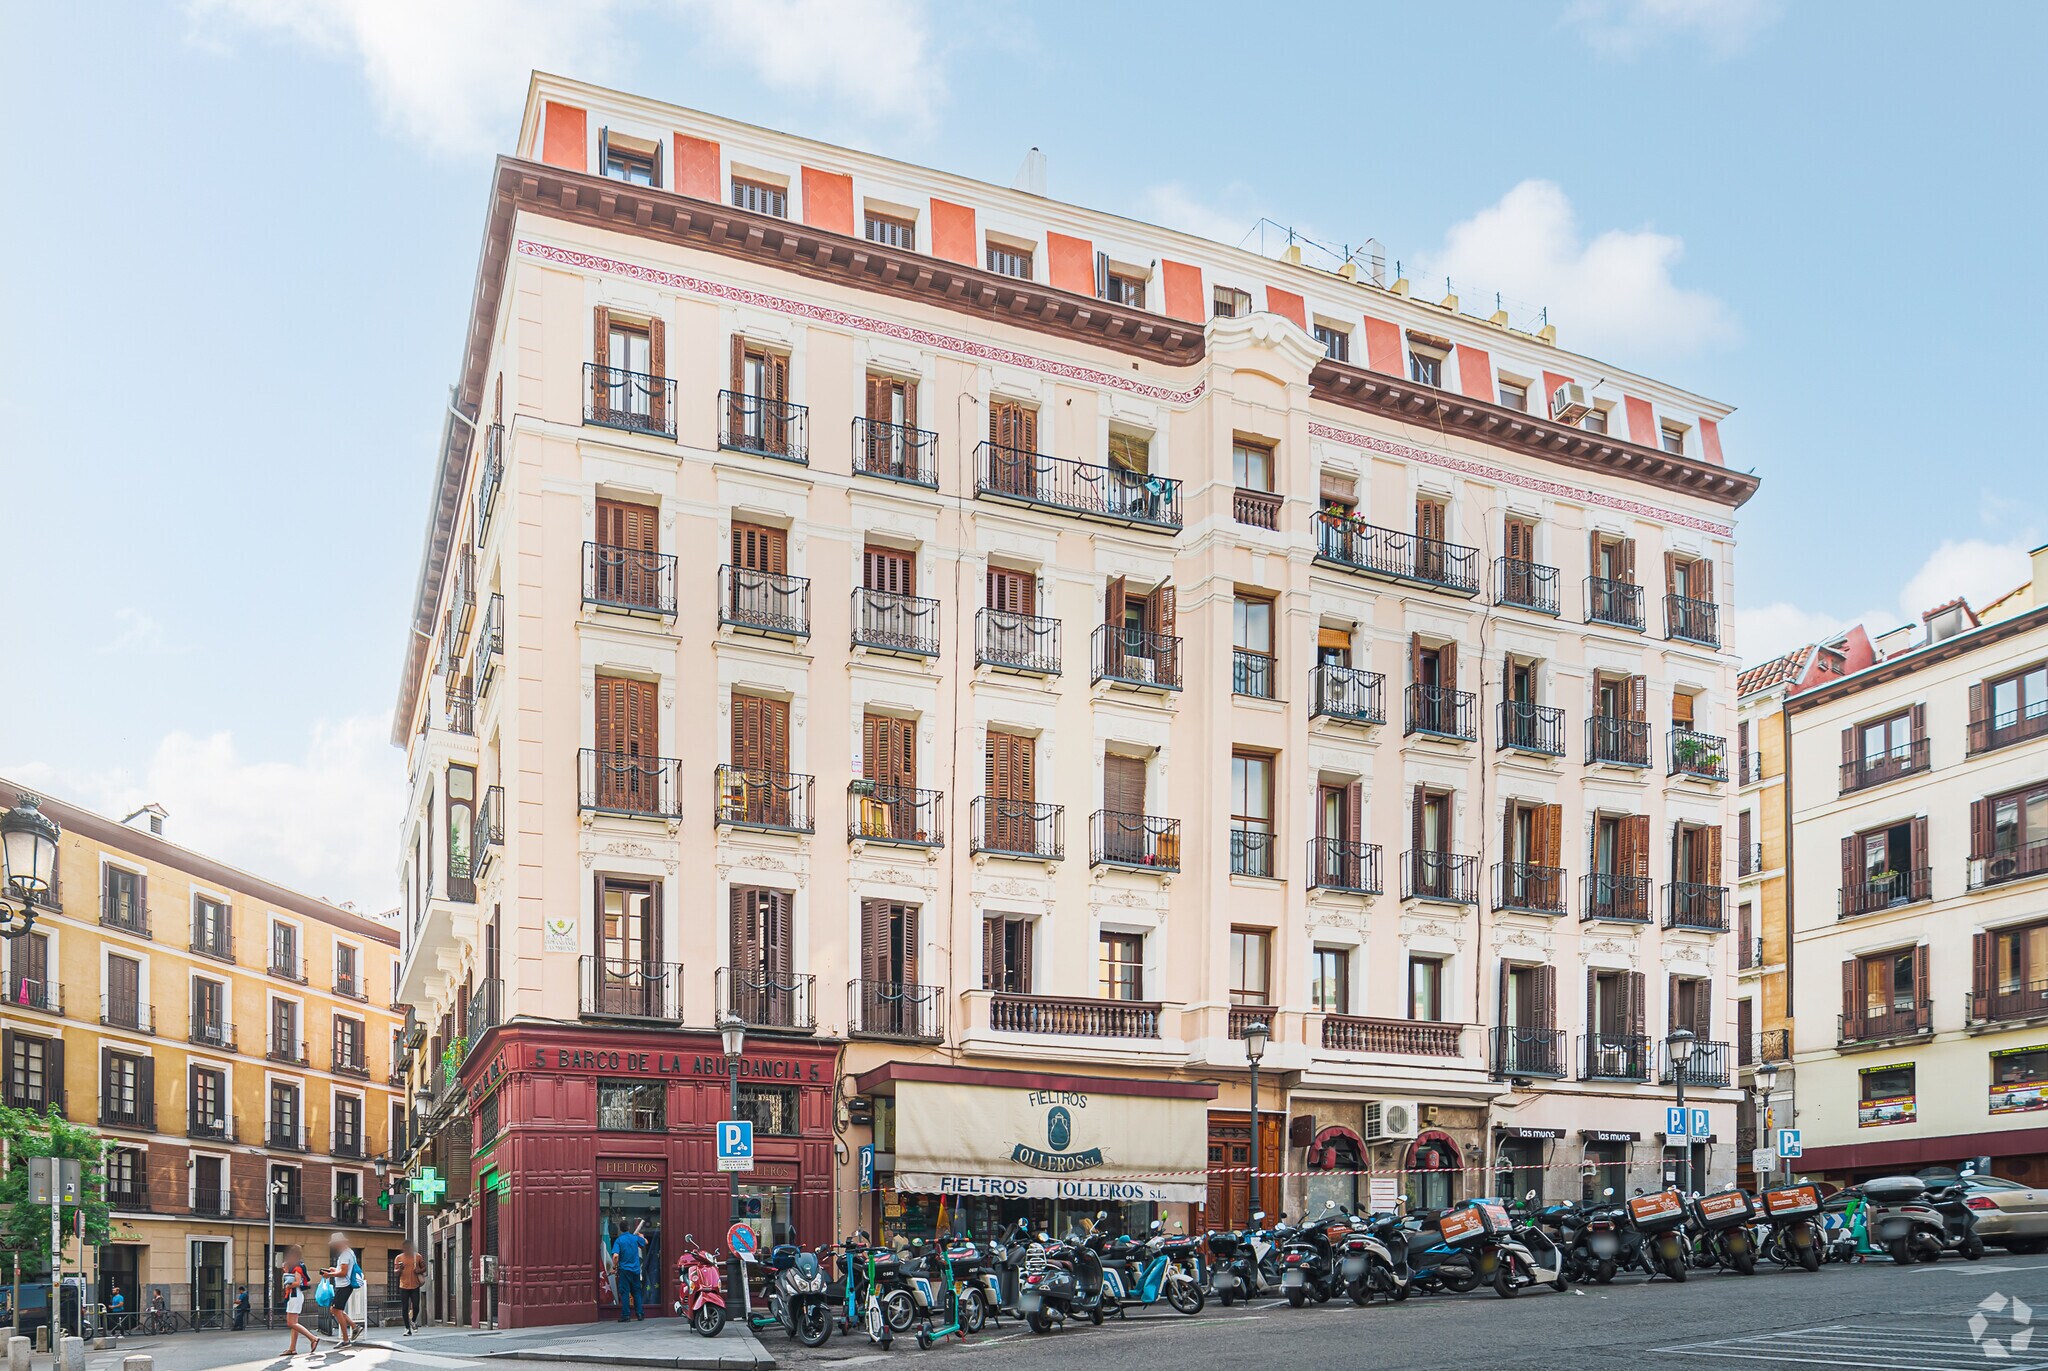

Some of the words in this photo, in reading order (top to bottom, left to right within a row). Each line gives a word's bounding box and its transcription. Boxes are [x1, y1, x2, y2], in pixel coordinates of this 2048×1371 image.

[558, 1048, 620, 1070] BARCO
[627, 1052, 650, 1071] DE
[658, 1053, 681, 1074] LA
[693, 1055, 802, 1080] ABUDANCIA
[809, 1063, 819, 1082] 5
[1028, 1091, 1088, 1109] FIELTROS
[1519, 1127, 1532, 1138] las
[1533, 1130, 1555, 1138] muns
[1671, 1109, 1681, 1133] P
[1695, 1110, 1705, 1134] P
[725, 1124, 742, 1154] P
[1598, 1130, 1609, 1140] las
[1610, 1133, 1631, 1141] muns
[1783, 1131, 1795, 1154] P
[606, 1162, 658, 1173] FIELTROS
[1020, 1148, 1084, 1172] OLLEROS
[941, 1177, 1028, 1194] FIELTROS
[1063, 1181, 1144, 1199] OLLEROS
[1149, 1189, 1167, 1199] S.L.
